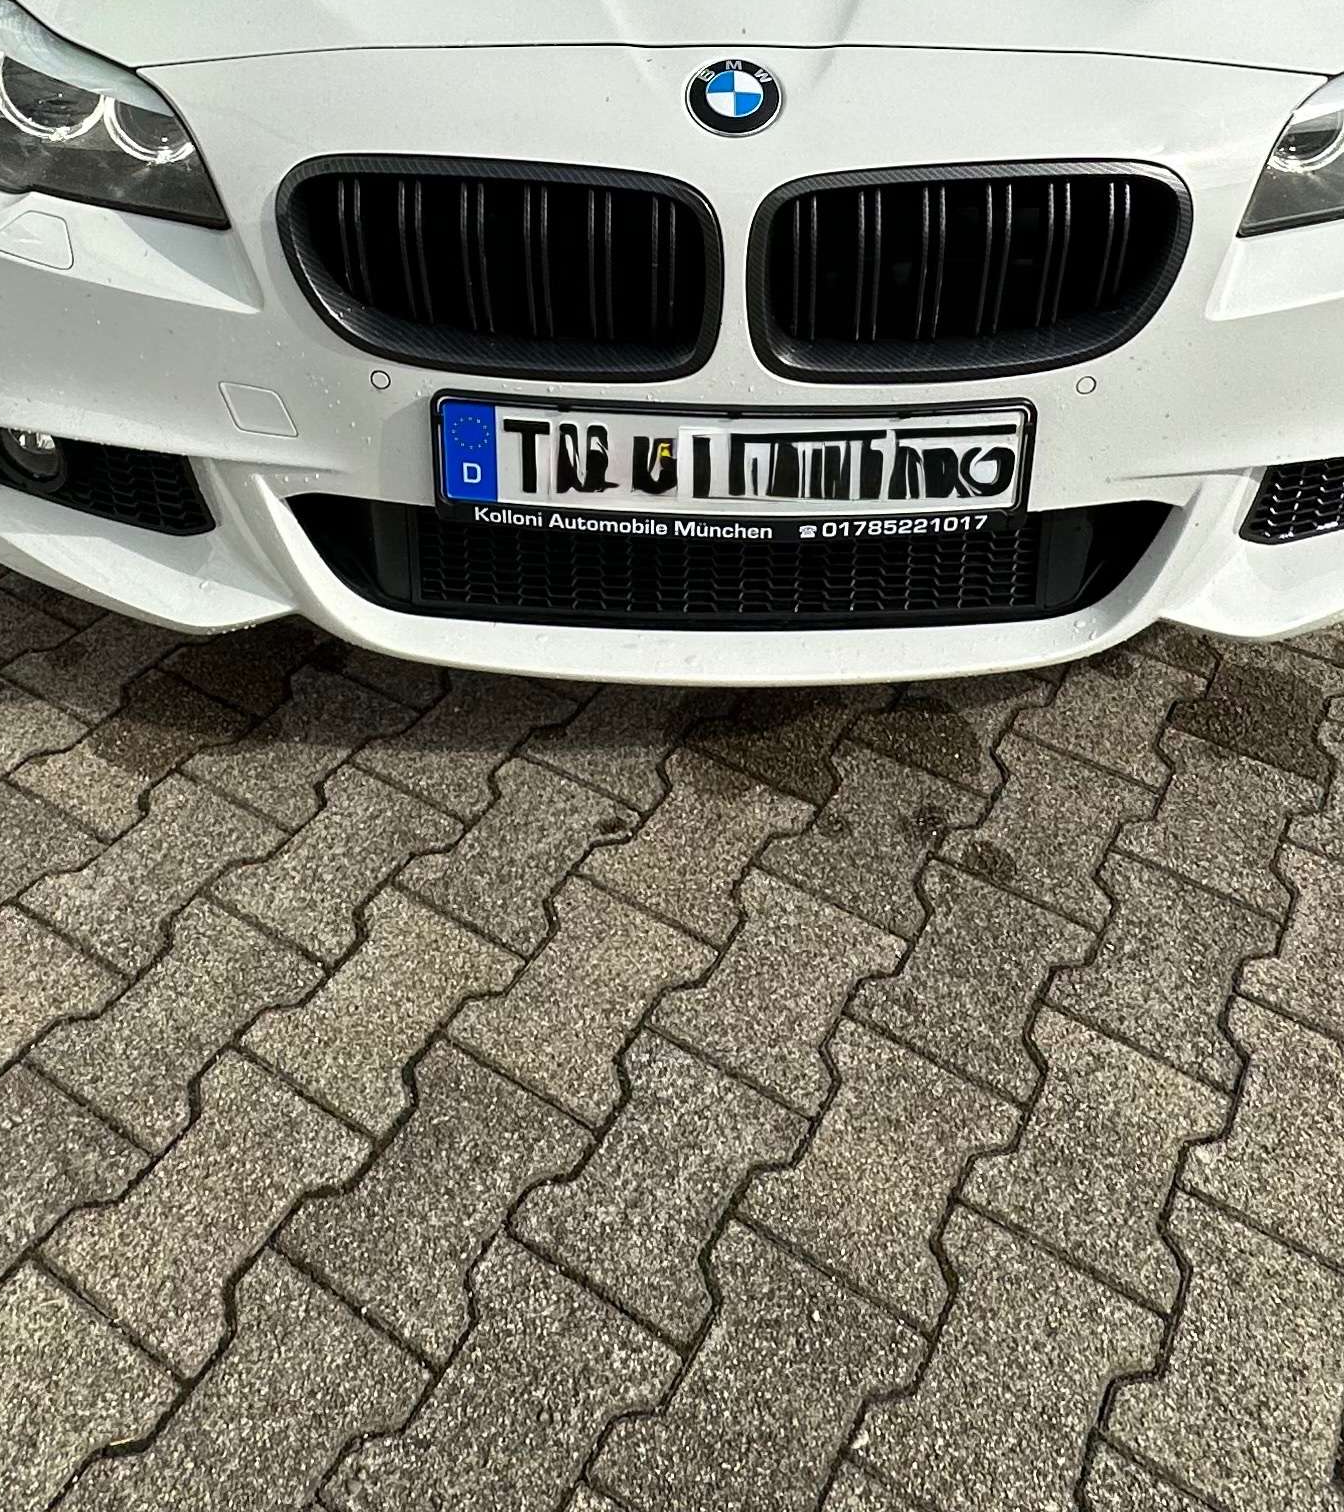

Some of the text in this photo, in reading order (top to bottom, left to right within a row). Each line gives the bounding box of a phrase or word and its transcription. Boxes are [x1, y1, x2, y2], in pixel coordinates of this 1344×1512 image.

[698, 60, 773, 84] BMW
[462, 462, 482, 484] D
[474, 506, 988, 539] Kolloni Automobile München 01785221017
